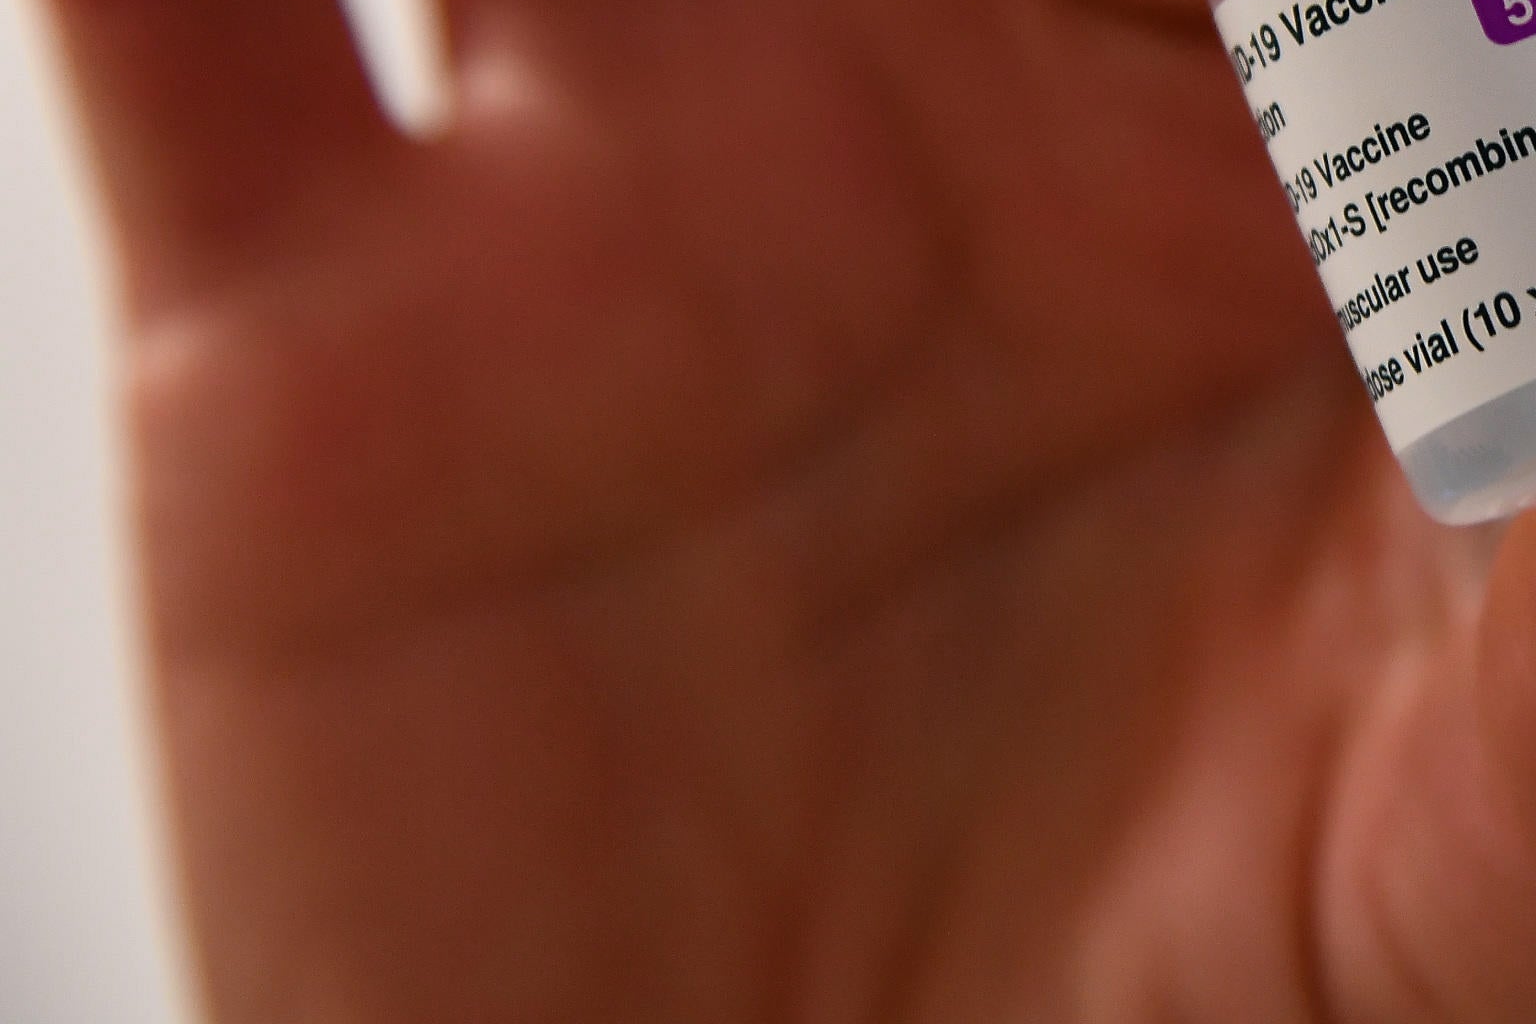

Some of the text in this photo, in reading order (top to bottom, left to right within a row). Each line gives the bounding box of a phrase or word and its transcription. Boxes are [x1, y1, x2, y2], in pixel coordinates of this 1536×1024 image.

[1256, 101, 1287, 142] ion
[1312, 112, 1431, 189] Vaccine
[1415, 235, 1480, 285] use
[1402, 317, 1460, 375] vial
[1462, 290, 1522, 353] (10
